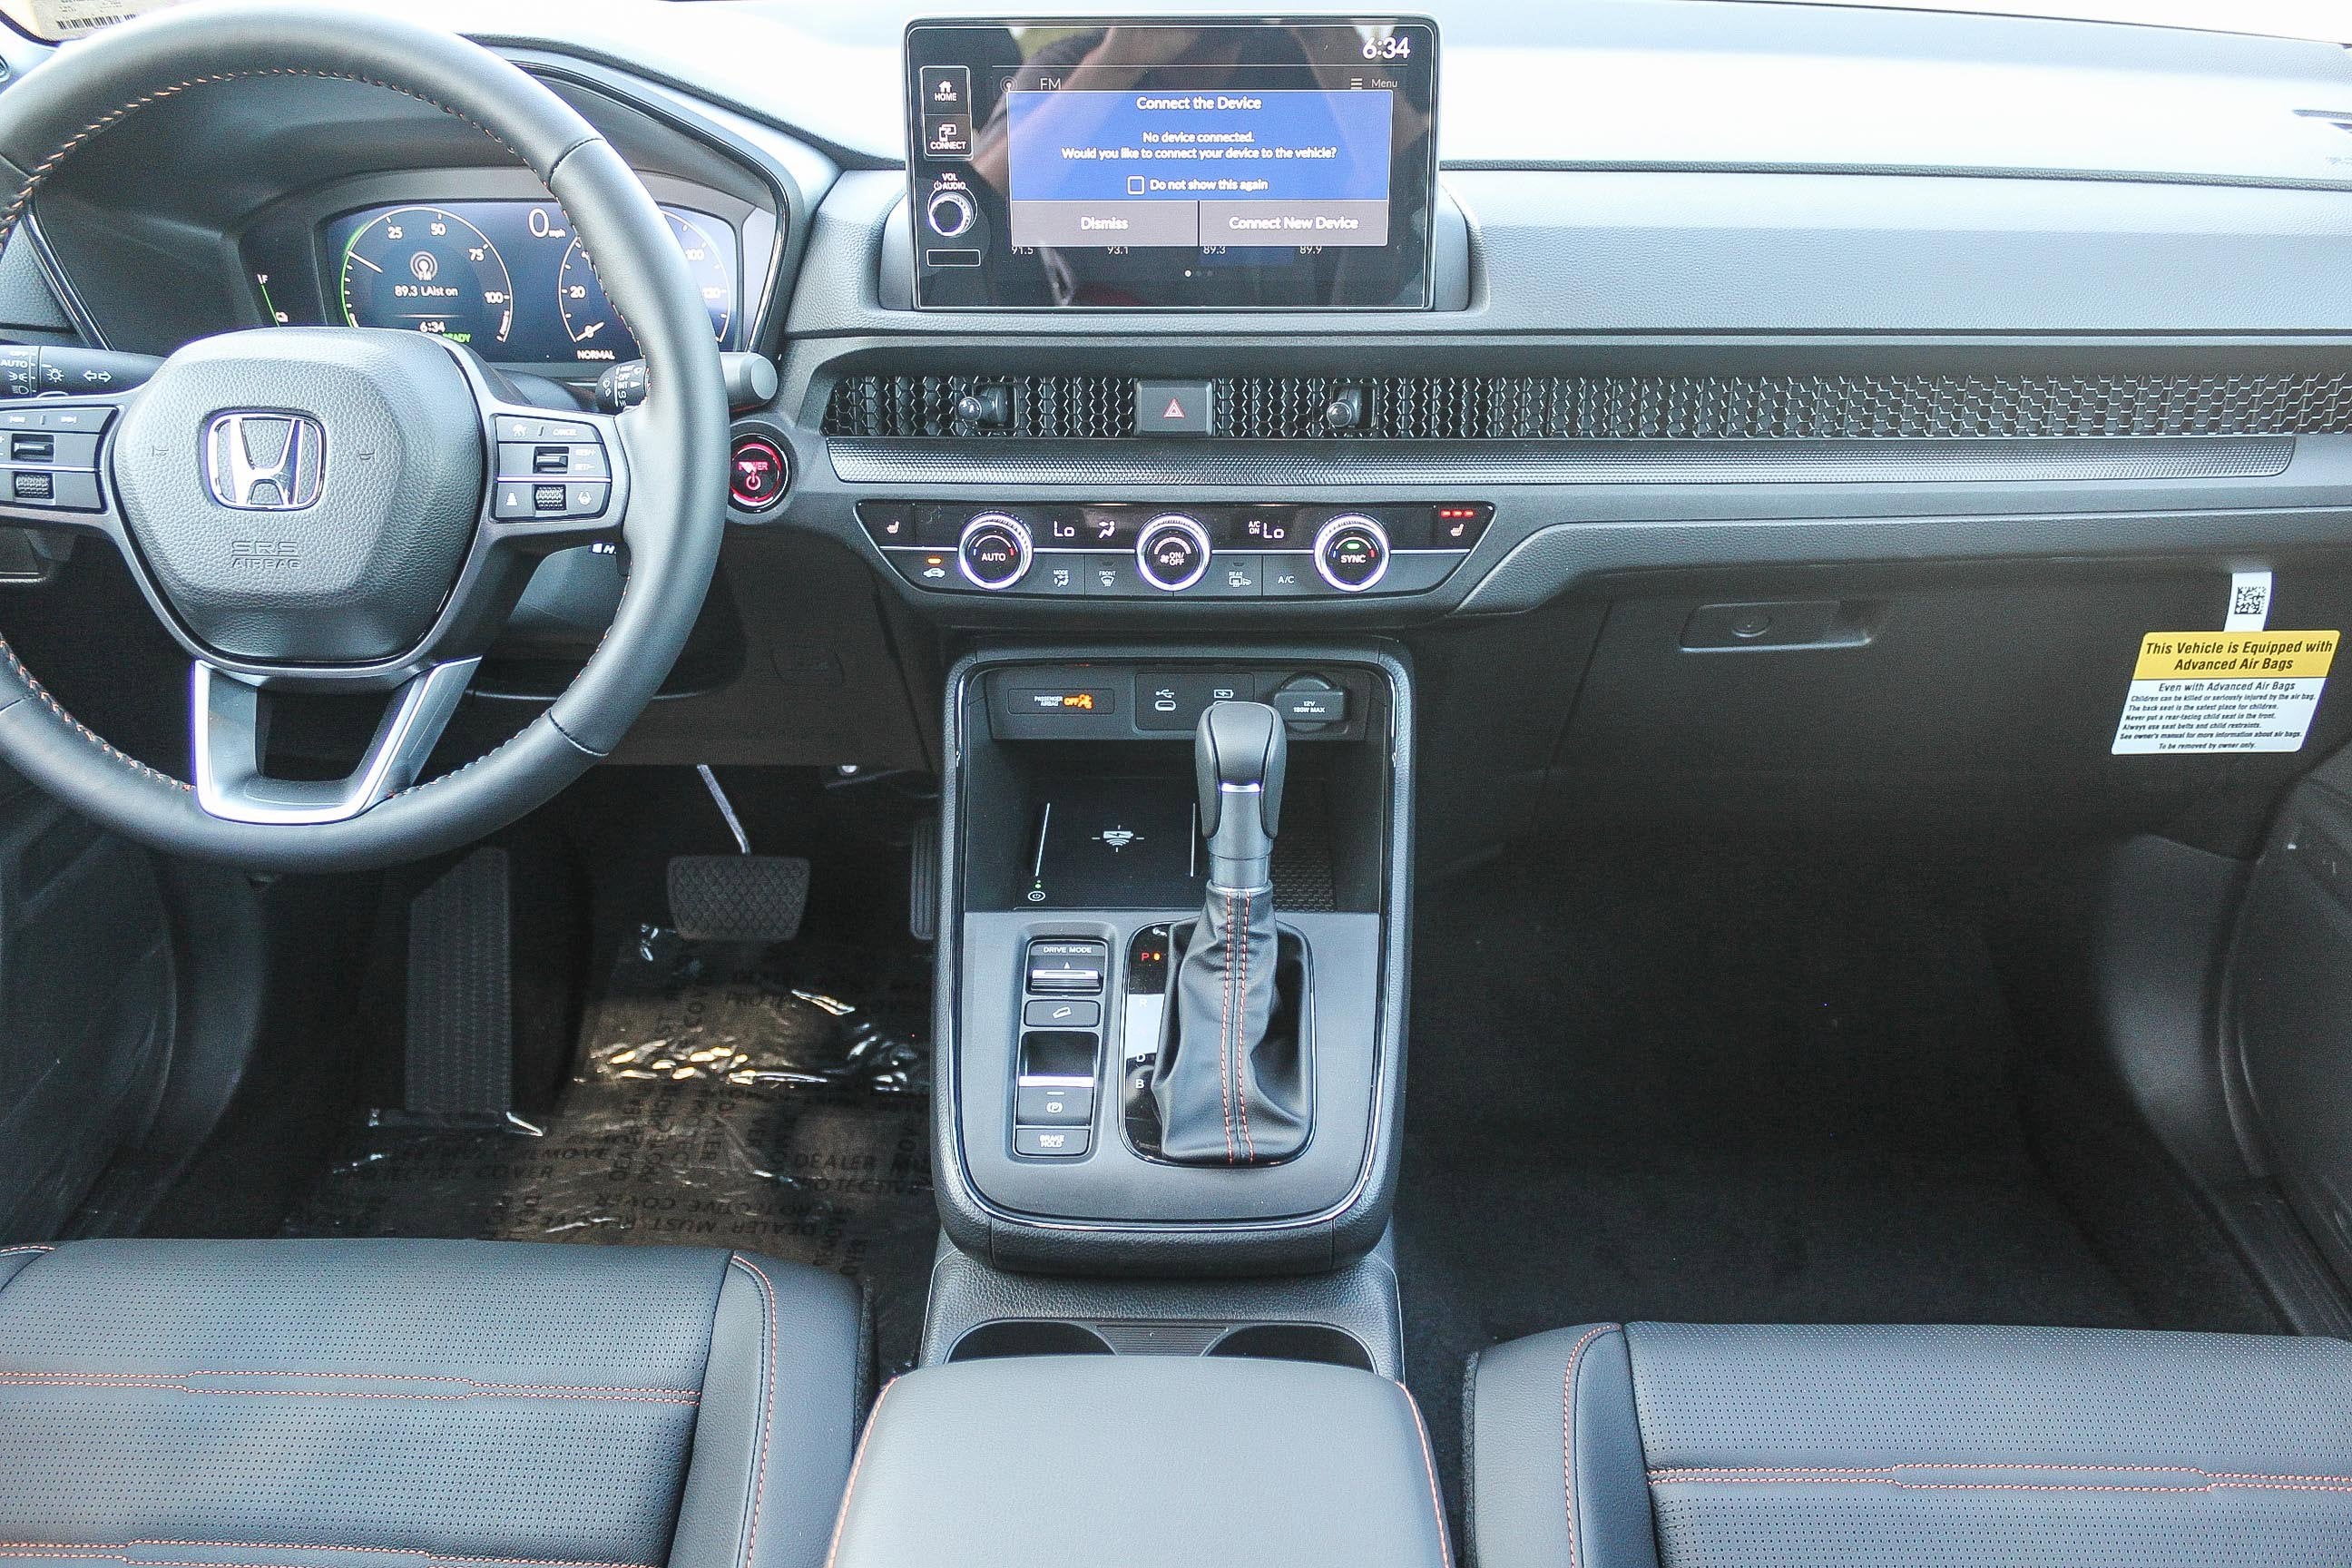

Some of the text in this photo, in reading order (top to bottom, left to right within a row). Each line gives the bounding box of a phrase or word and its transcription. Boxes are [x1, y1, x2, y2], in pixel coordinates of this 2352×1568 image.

[1362, 36, 1411, 59] 6:34
[1040, 78, 1062, 91] FM
[1371, 78, 1398, 89] Menu
[935, 93, 957, 102] HOME
[1136, 95, 1262, 110] Connect the Device
[1142, 131, 1255, 143] No device connected.
[930, 141, 966, 150] CONNECT
[1061, 146, 1338, 161] Would you like to connect your device to the vehicle?
[941, 172, 957, 181] VOL
[942, 181, 966, 191] AUDIO
[1149, 179, 1269, 192] Do not show this again
[528, 208, 550, 238] 0
[1080, 216, 1129, 230] Dismiss
[1229, 216, 1359, 230] Connect New Device
[387, 225, 403, 240] 25
[429, 222, 446, 237] 50
[468, 248, 485, 261] 75
[394, 284, 418, 297] 89.3
[569, 285, 585, 299] 20
[484, 291, 505, 304] 100
[419, 321, 446, 333] 6:34
[576, 350, 615, 360] NORMAL
[1248, 520, 1261, 528] A/C
[231, 540, 299, 554] SRS
[981, 553, 1006, 562] AUTO
[1169, 558, 1185, 566] OFF
[1340, 554, 1367, 564] SYNC
[1277, 575, 1295, 584] A/C
[2146, 640, 2333, 655] This Vehicle is Equipped with
[2174, 658, 2294, 671] Advanced Air Bags
[2159, 681, 2296, 691] Even with Advanced Air Bags
[1141, 953, 1149, 961] P
[1136, 1053, 1146, 1063] D
[1135, 1079, 1144, 1089] B
